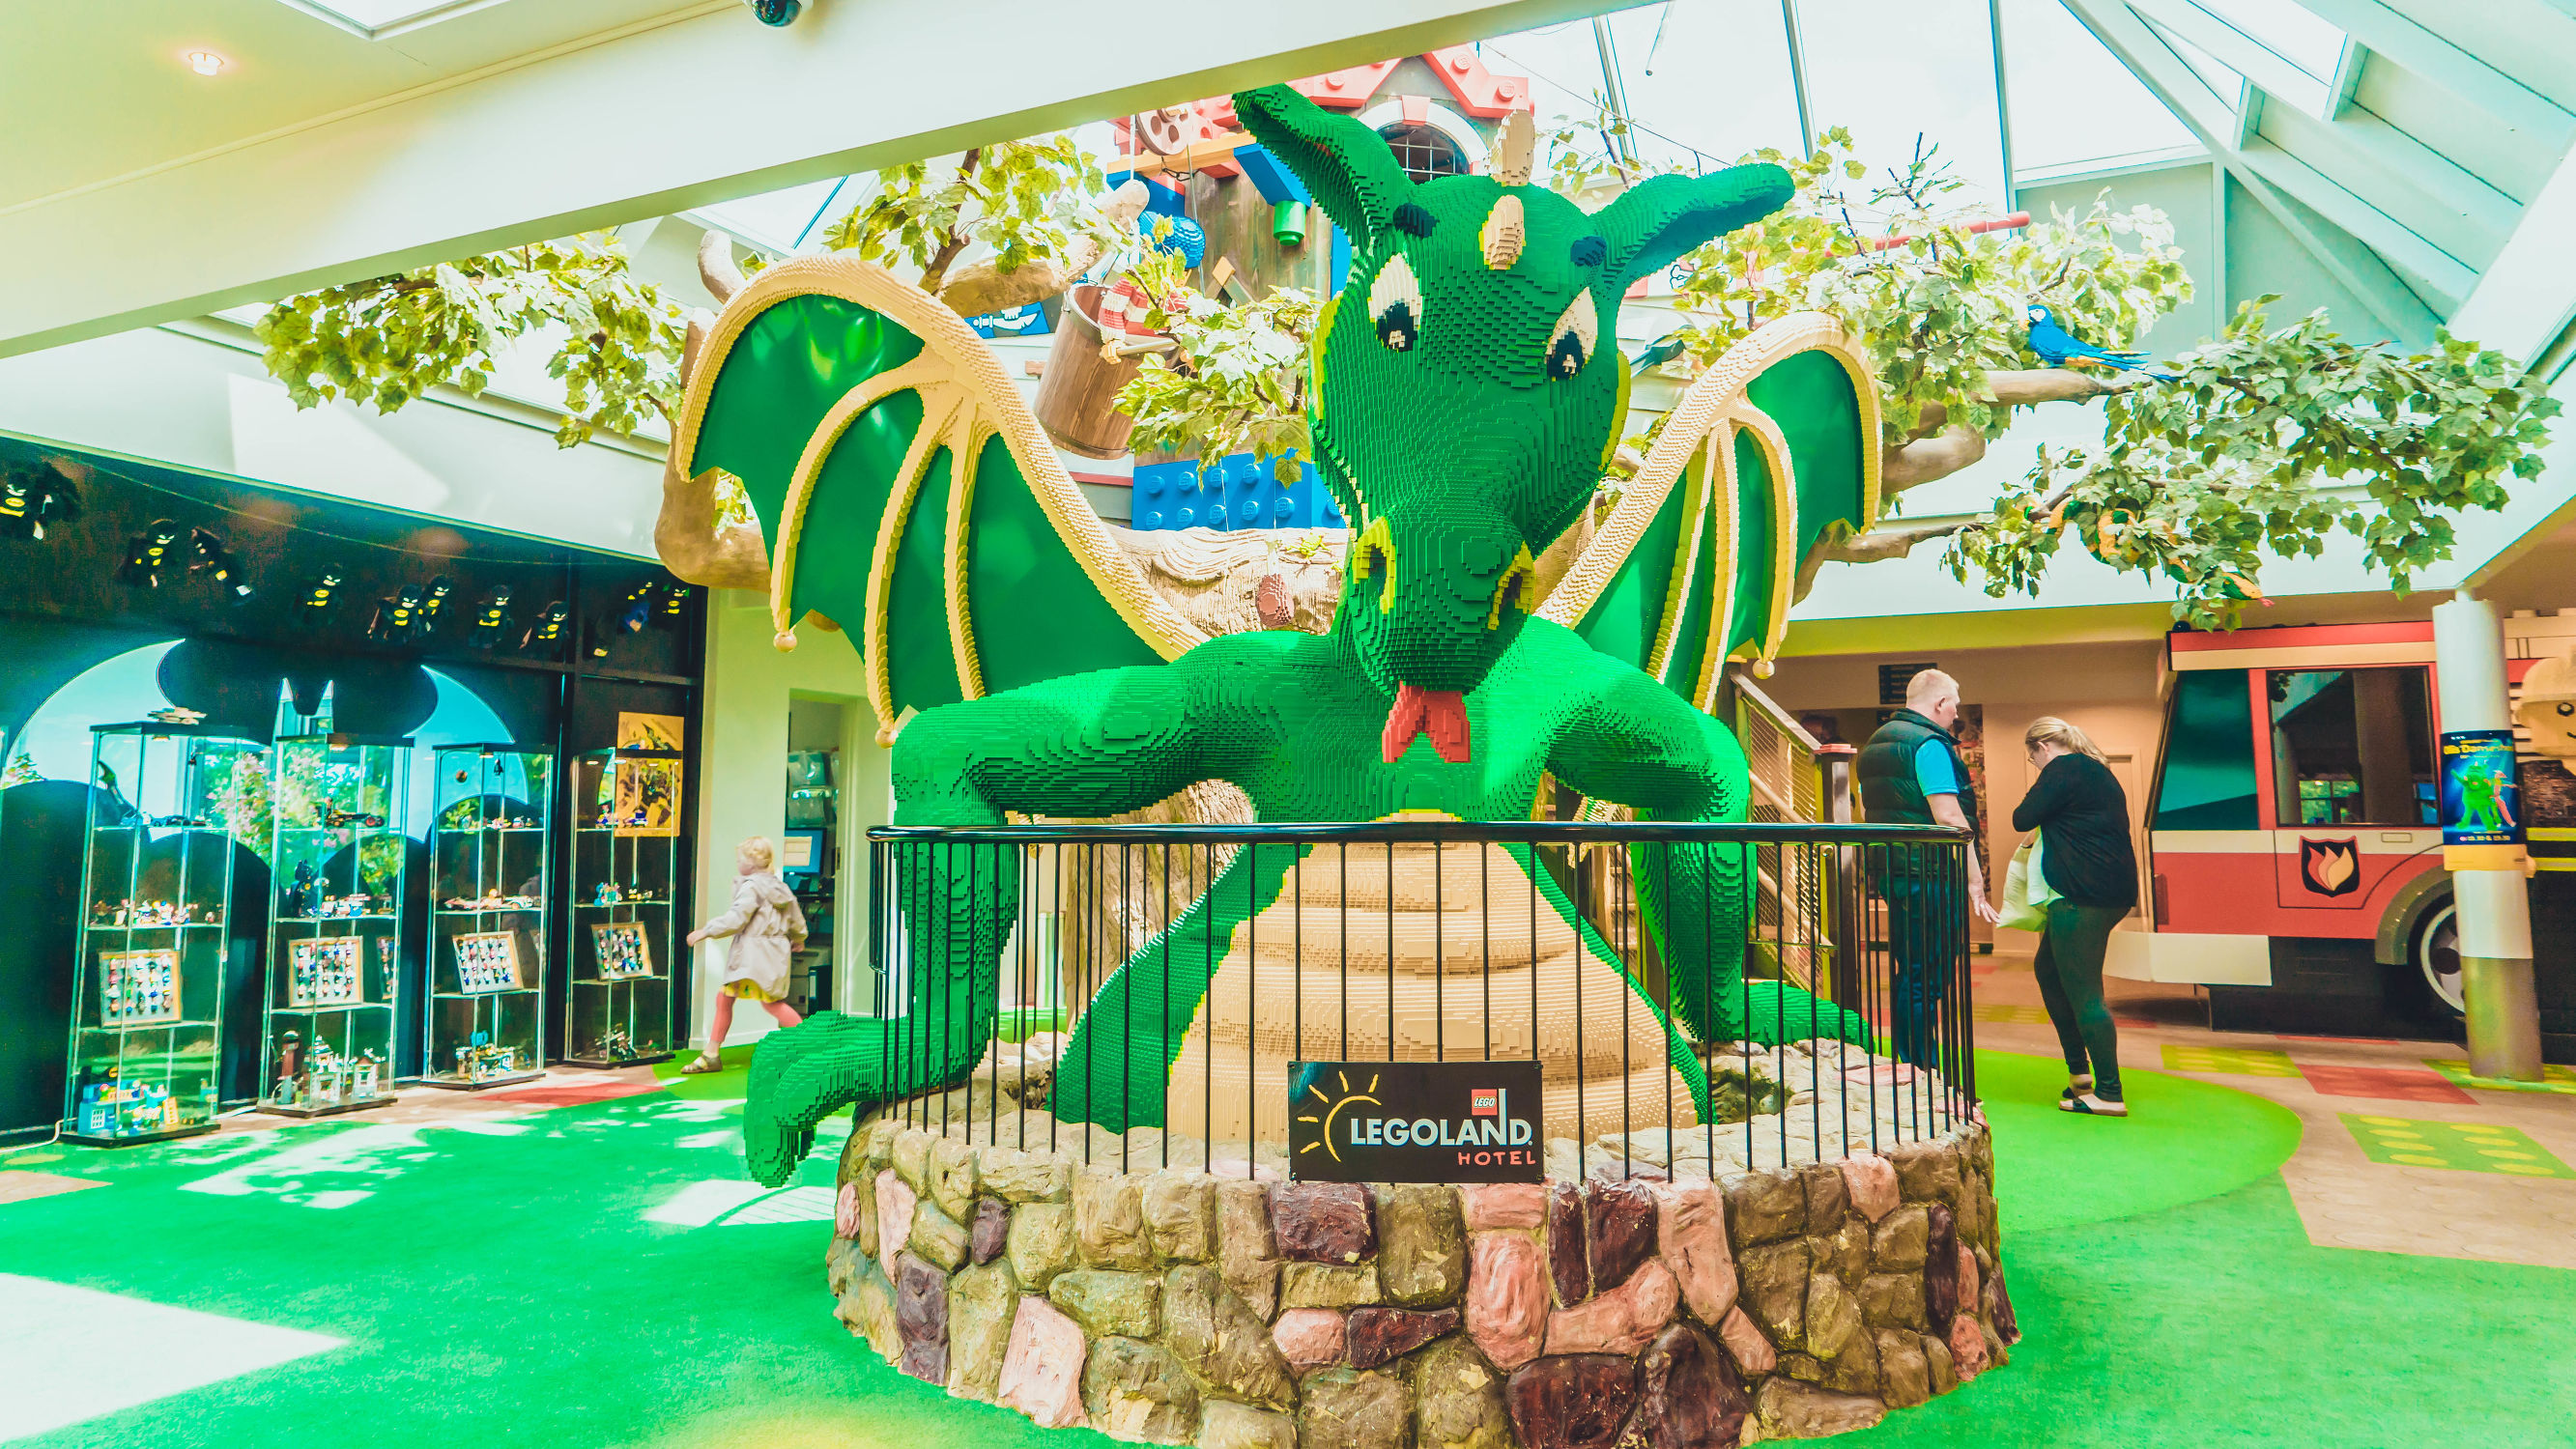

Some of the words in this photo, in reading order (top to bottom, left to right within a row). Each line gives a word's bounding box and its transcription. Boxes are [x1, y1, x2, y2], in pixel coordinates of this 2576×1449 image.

[1474, 1096, 1497, 1108] LEGO
[1351, 1088, 1532, 1147] LEGOLAND
[1457, 1151, 1536, 1166] HOTEL
